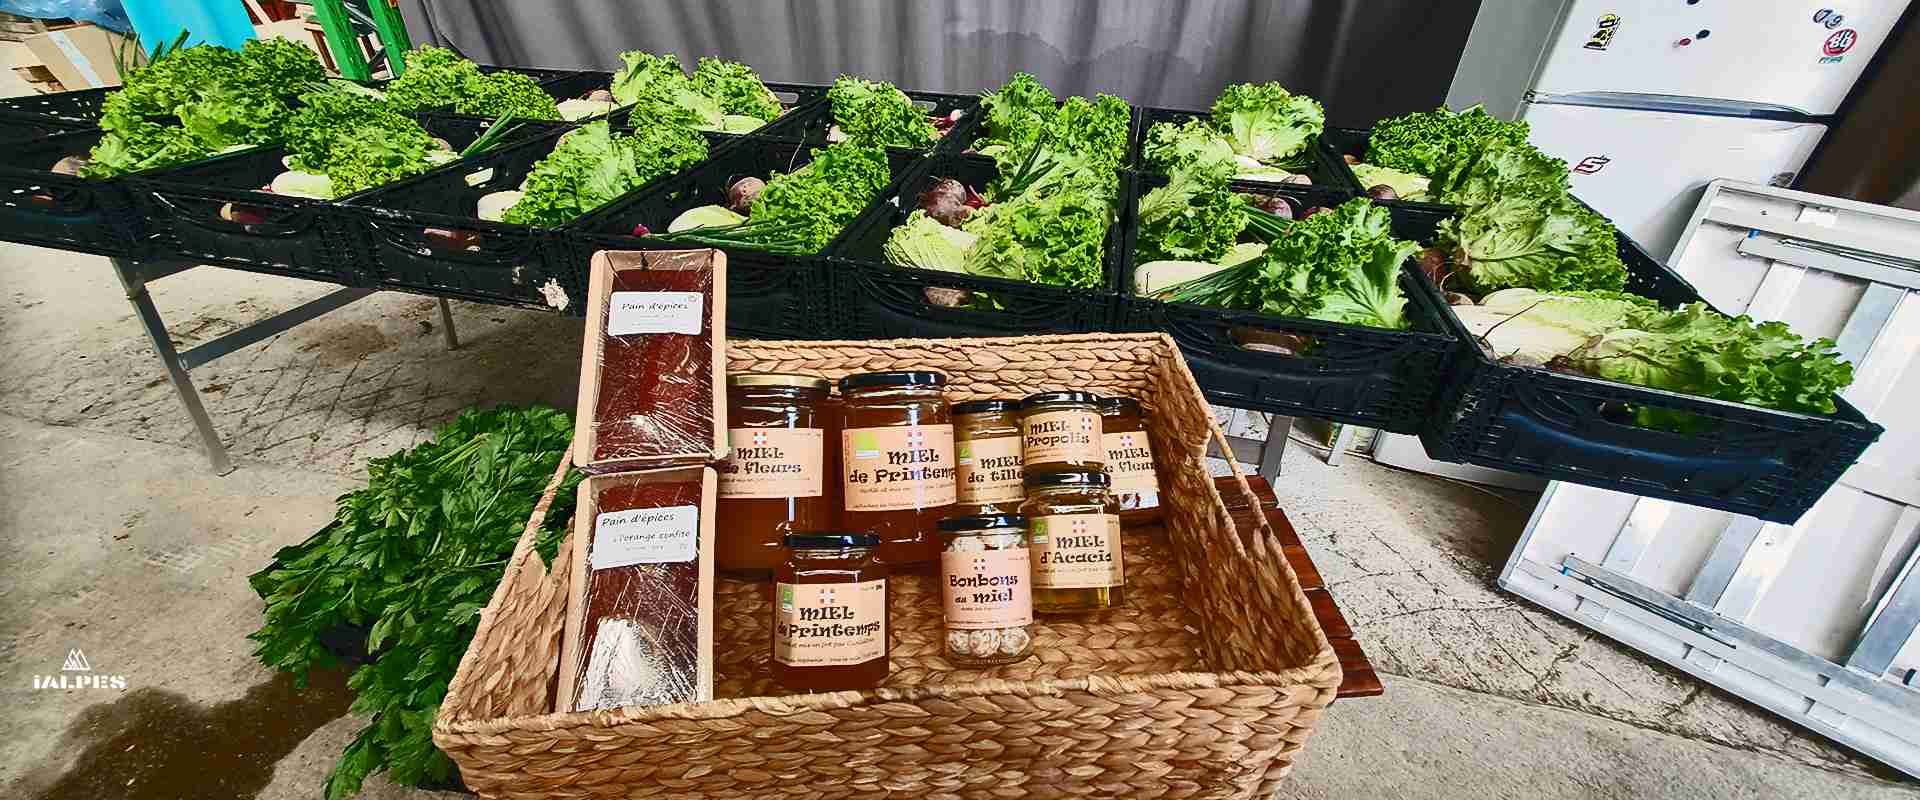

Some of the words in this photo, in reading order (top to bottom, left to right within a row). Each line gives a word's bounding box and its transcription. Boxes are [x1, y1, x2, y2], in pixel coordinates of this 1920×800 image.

[621, 302, 645, 311] Pain
[1030, 420, 1071, 435] MIEL
[736, 447, 784, 460] MIEL
[887, 448, 940, 465] MIEL
[1108, 448, 1150, 460] MIEL
[743, 462, 801, 474] fleurs
[980, 455, 1024, 469] MIEL
[849, 469, 868, 484] de
[875, 466, 957, 484] Printemp
[967, 472, 985, 483] de
[990, 469, 1024, 481] tille
[602, 517, 626, 527] Pain
[630, 512, 674, 526] d'épices
[1056, 535, 1105, 549] MIEL
[1040, 549, 1113, 564] d'Acacia
[949, 573, 1018, 588] Bonbons
[973, 588, 1013, 604] miel
[799, 606, 855, 621] MIEL
[788, 620, 881, 639] Printemps
